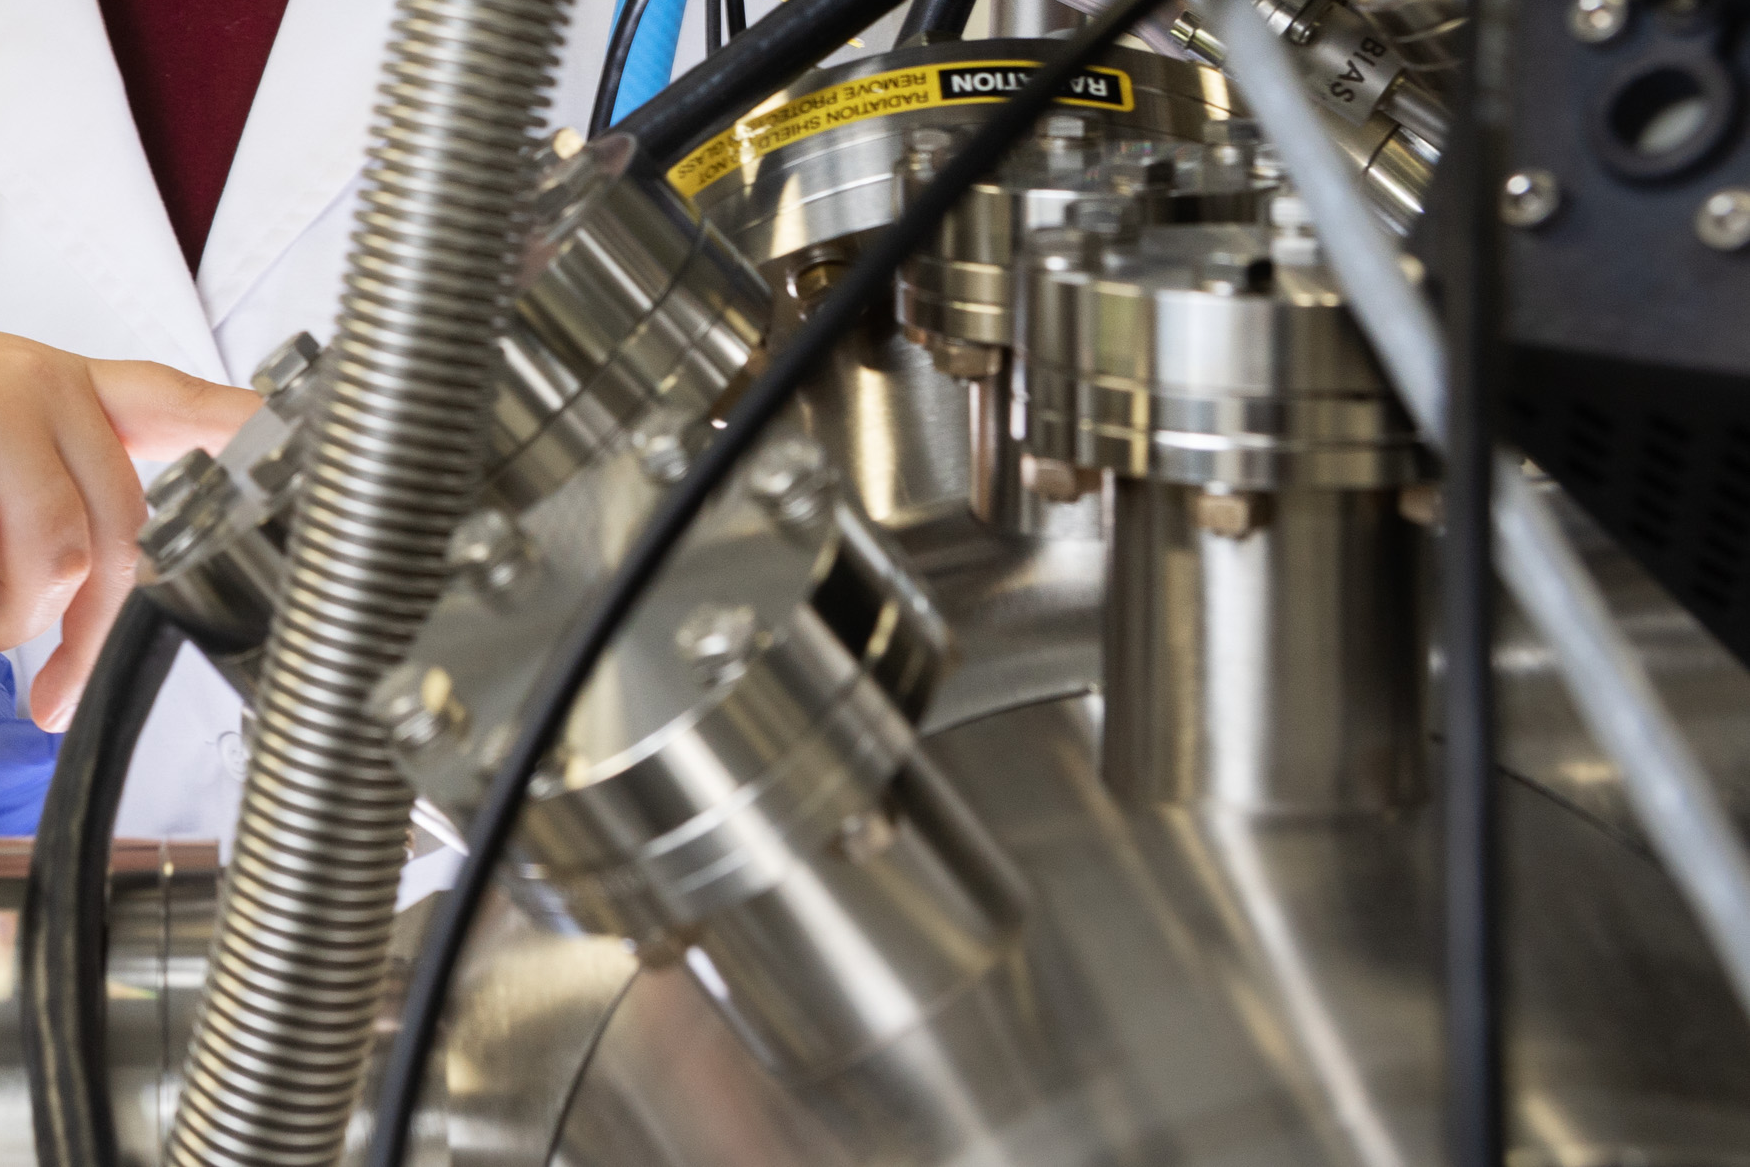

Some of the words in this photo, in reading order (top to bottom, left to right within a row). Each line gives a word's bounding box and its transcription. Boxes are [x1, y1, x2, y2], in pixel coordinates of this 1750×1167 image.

[844, 71, 928, 100] REMOVE
[951, 71, 1108, 98] RATION
[1330, 37, 1387, 103] BIAS
[825, 90, 930, 125] RADIATION
[757, 114, 821, 150] SHIELD
